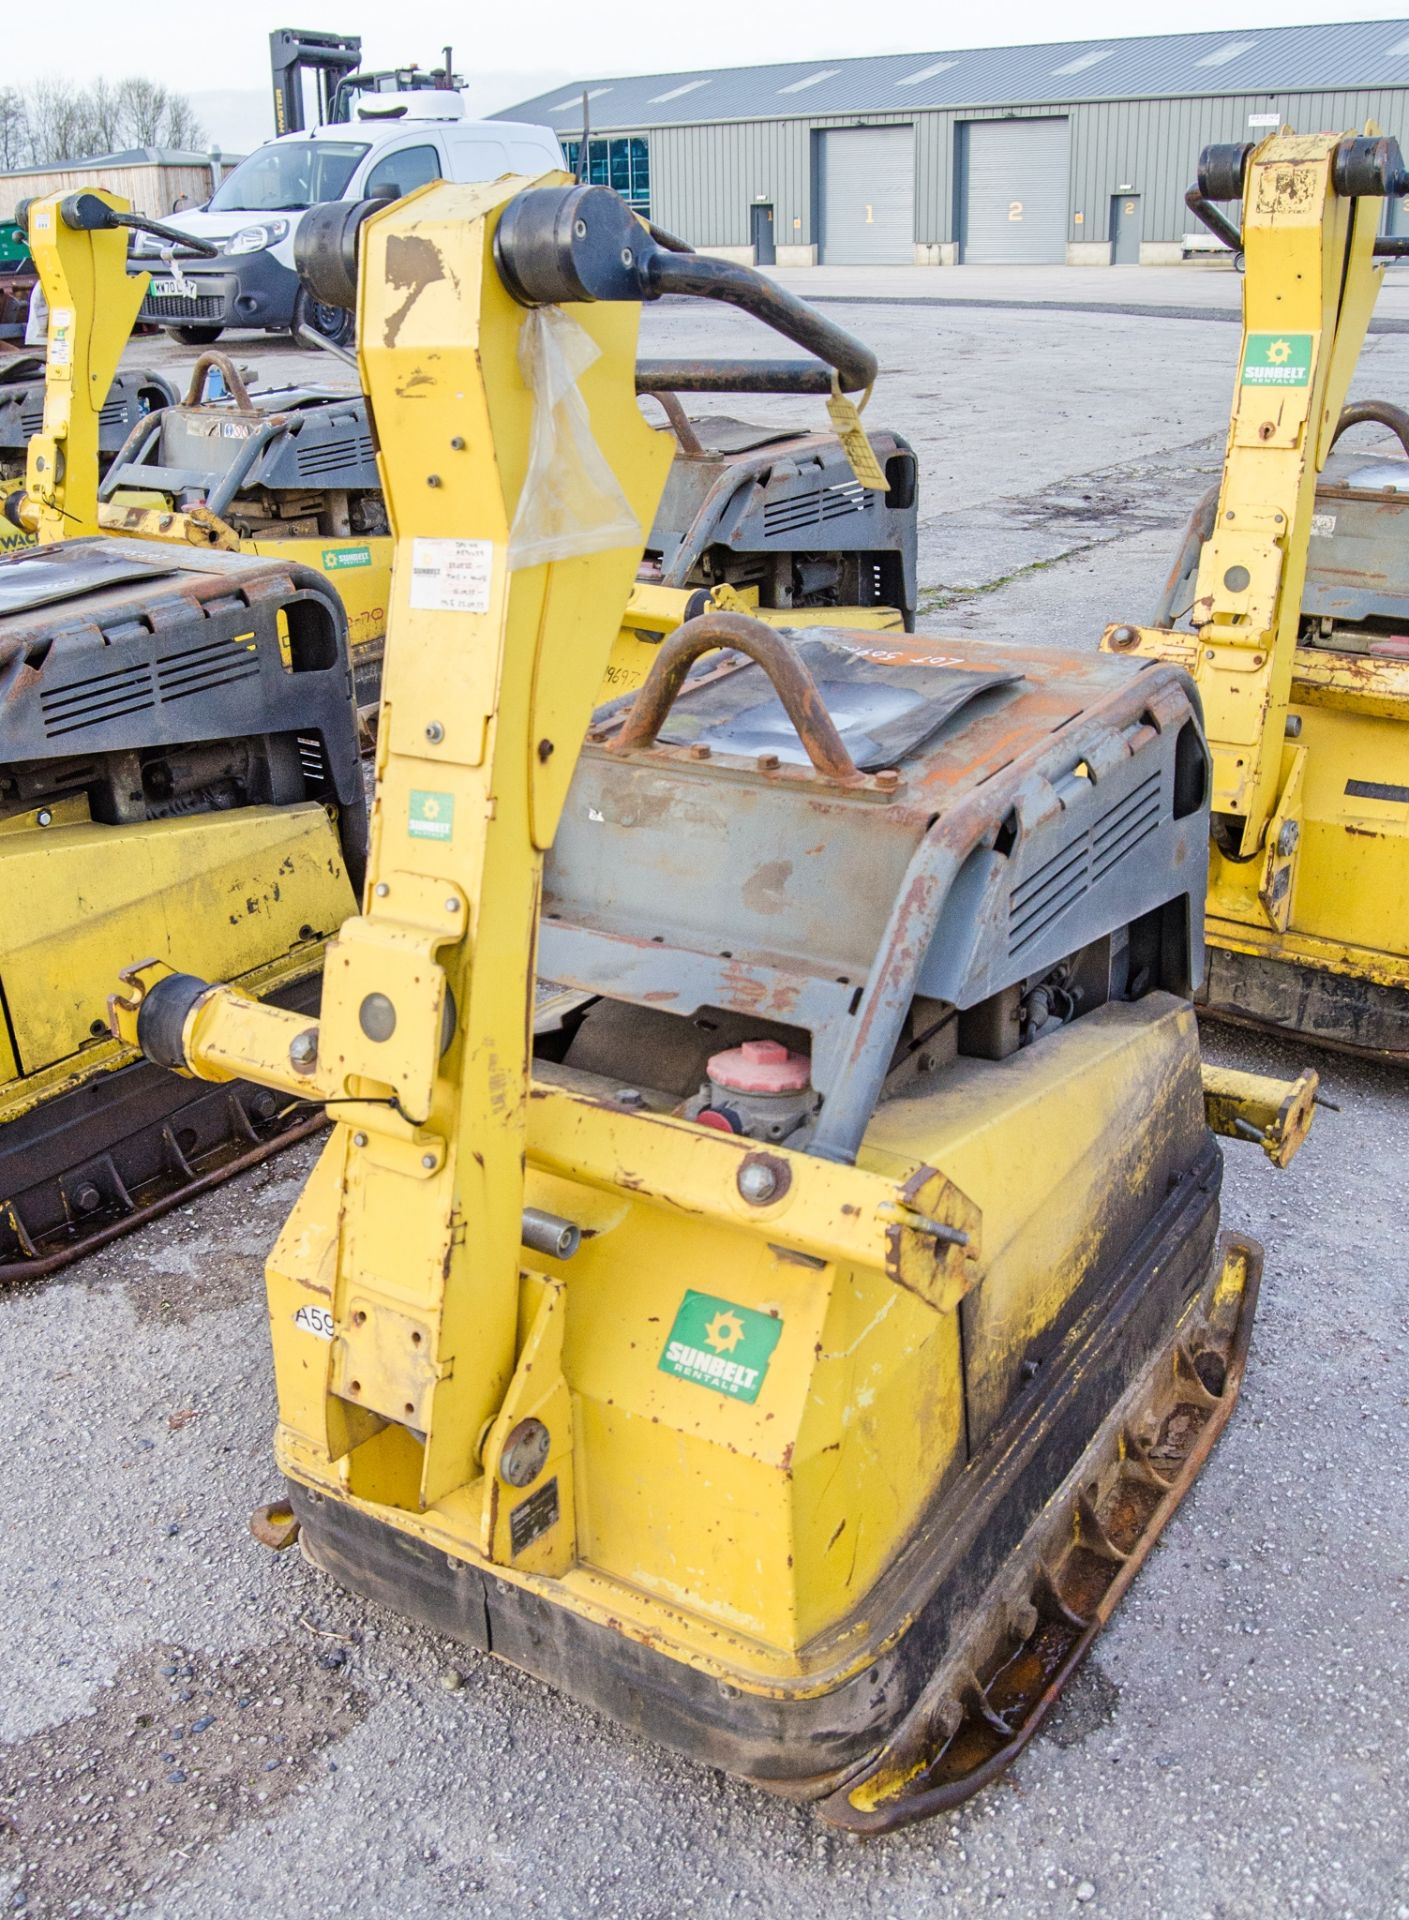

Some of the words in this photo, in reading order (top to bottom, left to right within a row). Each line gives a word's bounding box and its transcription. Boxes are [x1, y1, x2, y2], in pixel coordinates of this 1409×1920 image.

[275, 88, 286, 134] HYSTER
[767, 210, 773, 221] 1
[864, 204, 875, 224] 1
[1008, 201, 1024, 220] 2
[1124, 201, 1136, 215] 2
[1244, 366, 1306, 379] SUNBELT
[0, 531, 39, 550] WAC
[339, 552, 369, 562] SUNBELT
[413, 567, 441, 575] SUNBELT
[909, 655, 966, 668] LOT
[409, 819, 450, 833] SUNBELT
[295, 1306, 334, 1337] A59
[665, 1341, 760, 1391] SUNBELT
[673, 1363, 739, 1393] RENTALS
